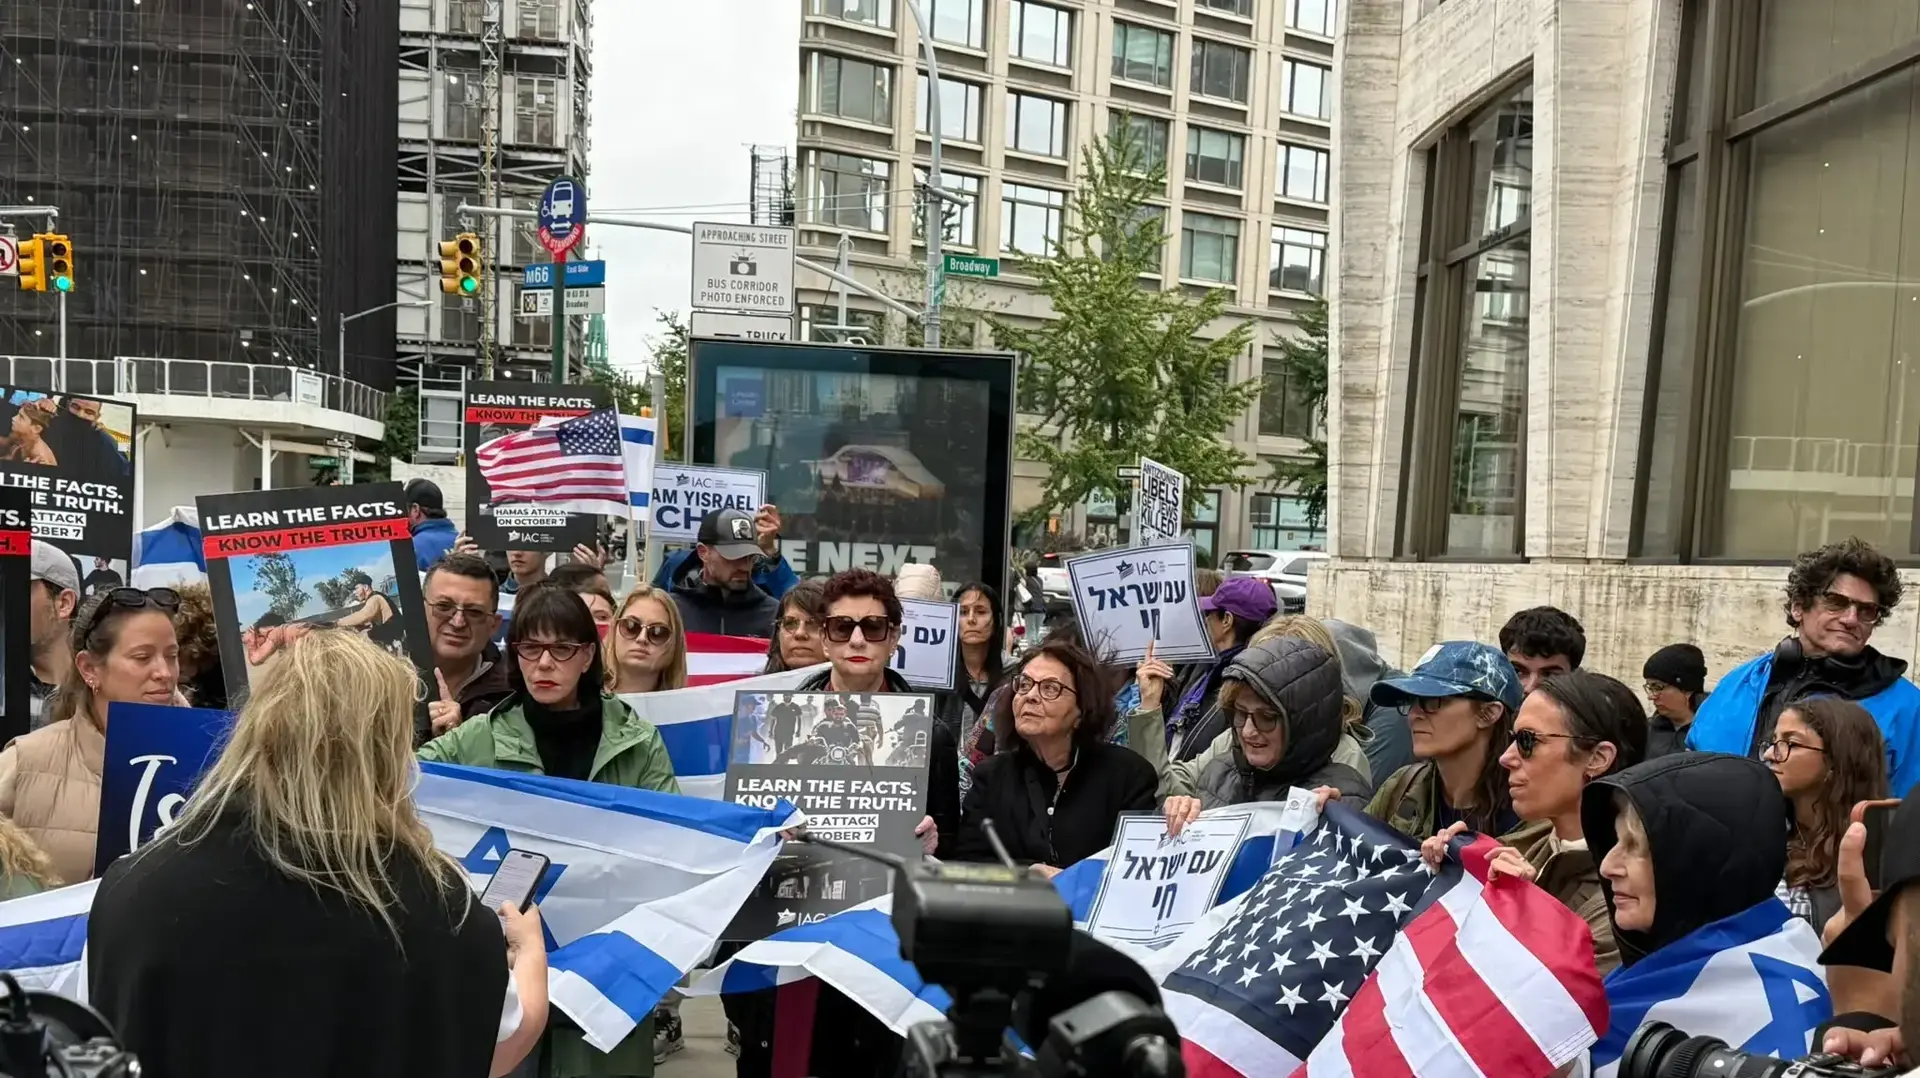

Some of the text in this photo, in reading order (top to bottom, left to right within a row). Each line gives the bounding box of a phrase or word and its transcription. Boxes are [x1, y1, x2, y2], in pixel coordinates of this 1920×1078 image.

[701, 229, 788, 244] APPROACHING STREET
[526, 266, 549, 284] M66
[950, 258, 990, 275] Broadway
[707, 278, 778, 292] BUS CORRIDOR
[700, 291, 784, 306] PHOTO ENFORCED
[746, 330, 786, 340] TRUCK
[470, 393, 596, 408] LEARN THE FACTS.
[475, 410, 515, 420] KNOW
[519, 411, 543, 421] THE
[10, 473, 51, 490] THE
[56, 479, 124, 500] FACTS.
[691, 477, 712, 488] IAC
[1142, 473, 1179, 507] LIBELS
[53, 493, 124, 515] TRUTH.
[684, 490, 754, 511] YISRAEL
[206, 501, 403, 531] LEARN THE FACTS.
[495, 508, 529, 516] HAMAS
[498, 518, 565, 526] ON OCTOBER 7
[72, 529, 81, 538] 7
[218, 525, 398, 552] KNOW THE TRUTH.
[521, 532, 540, 543] IAC
[818, 541, 937, 576] NEXT
[1136, 560, 1158, 576] IAC
[1088, 581, 1162, 611] ישראל
[914, 626, 946, 646] עם
[738, 778, 917, 796] LEARN THE FACTS.
[804, 795, 842, 810] THE
[847, 796, 917, 812] TRUTH.
[821, 816, 877, 827] ATTACK
[864, 831, 873, 841] 7
[1122, 849, 1225, 881] עם ישראל
[1151, 883, 1178, 921] חי
